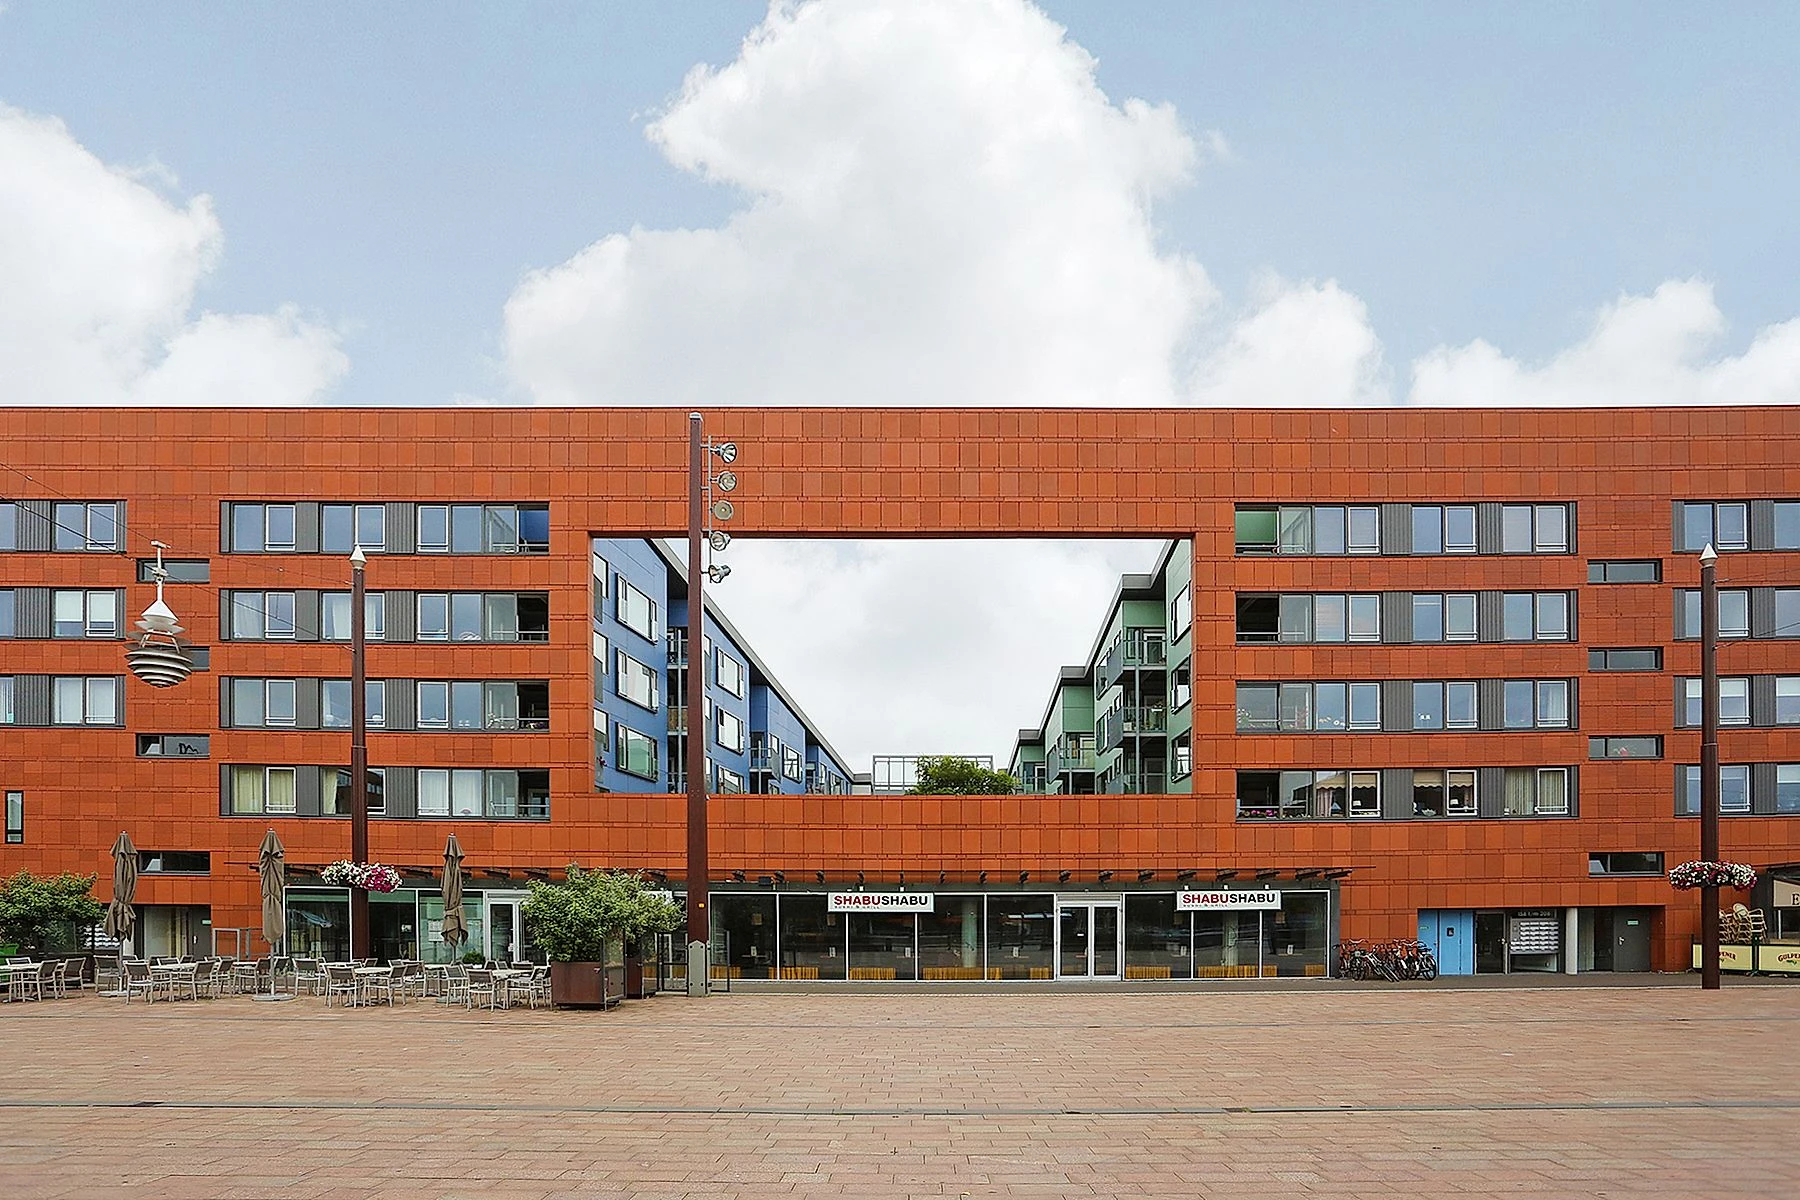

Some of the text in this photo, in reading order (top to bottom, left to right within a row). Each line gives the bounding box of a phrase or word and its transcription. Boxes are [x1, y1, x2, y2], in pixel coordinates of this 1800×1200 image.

[834, 895, 928, 905] SHABUSHABU
[1182, 893, 1276, 903] SHABUSHABU
[1778, 952, 1800, 962] GULPE
